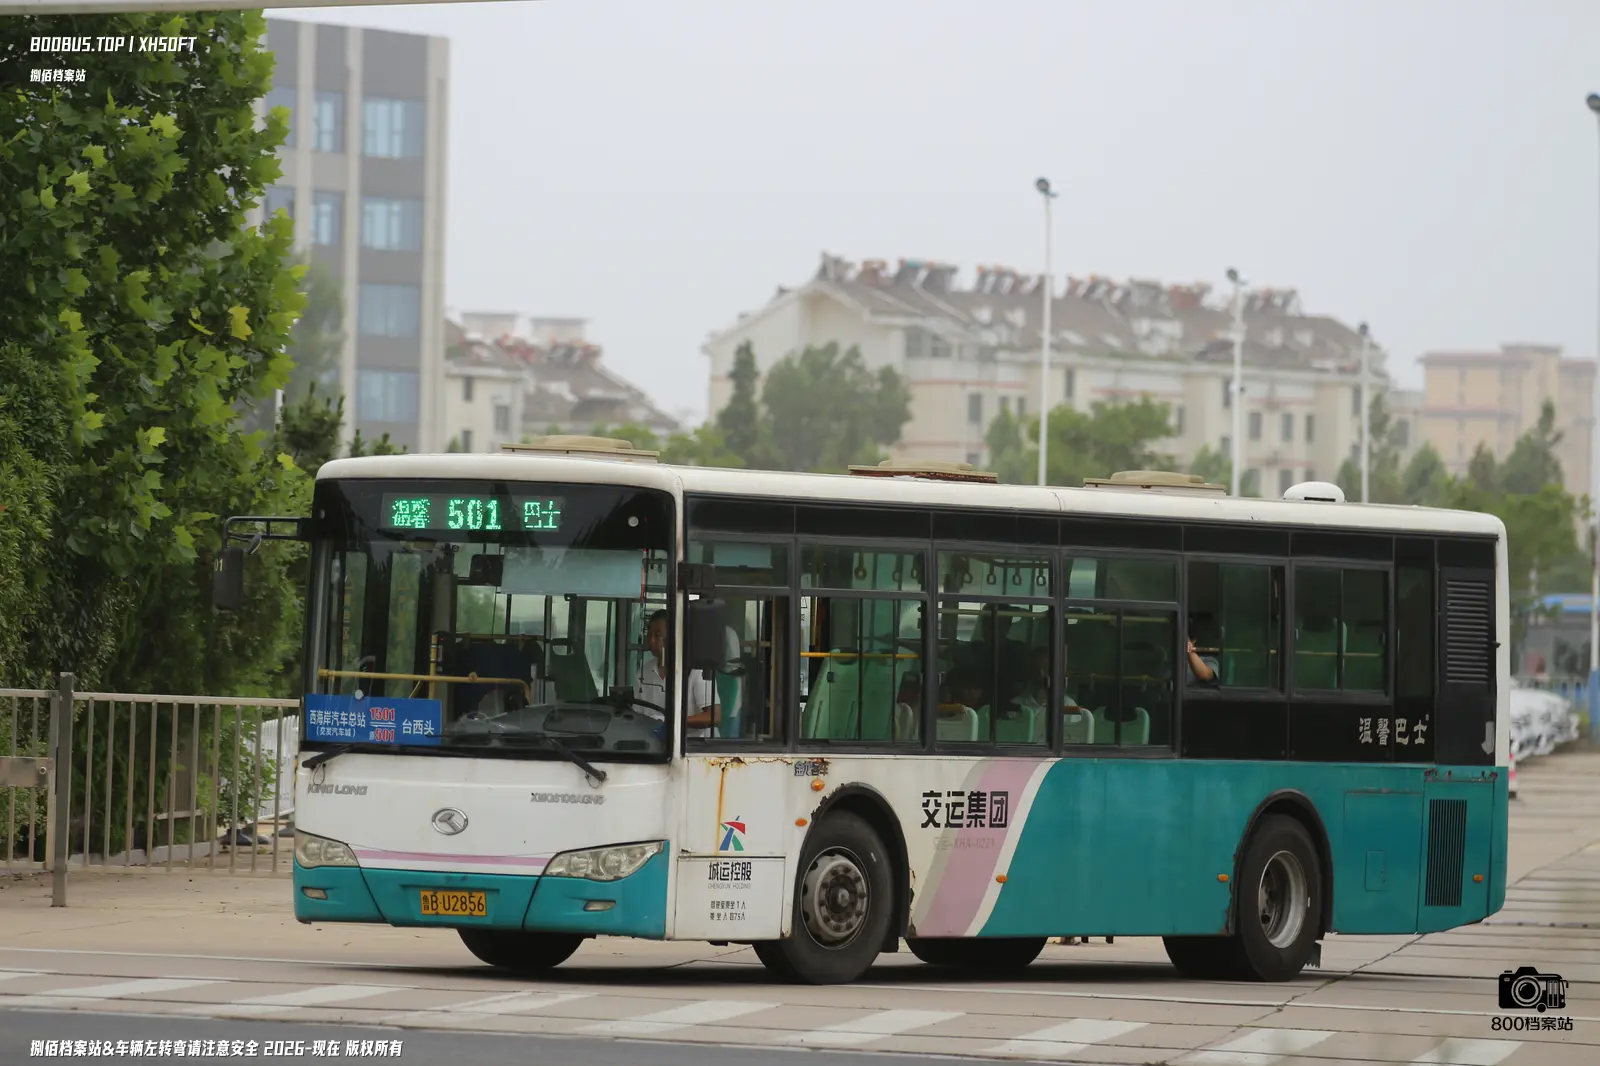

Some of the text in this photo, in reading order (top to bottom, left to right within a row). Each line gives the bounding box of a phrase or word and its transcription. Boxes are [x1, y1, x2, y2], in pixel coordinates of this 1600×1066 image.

[449, 499, 501, 530] 501
[309, 709, 366, 728] 西海岸汽车总站
[369, 707, 396, 721] 1501
[402, 719, 435, 735] 台西头
[334, 784, 369, 796] LONG
[920, 790, 1009, 829] 交运集团
[708, 861, 752, 881] 城运控股
